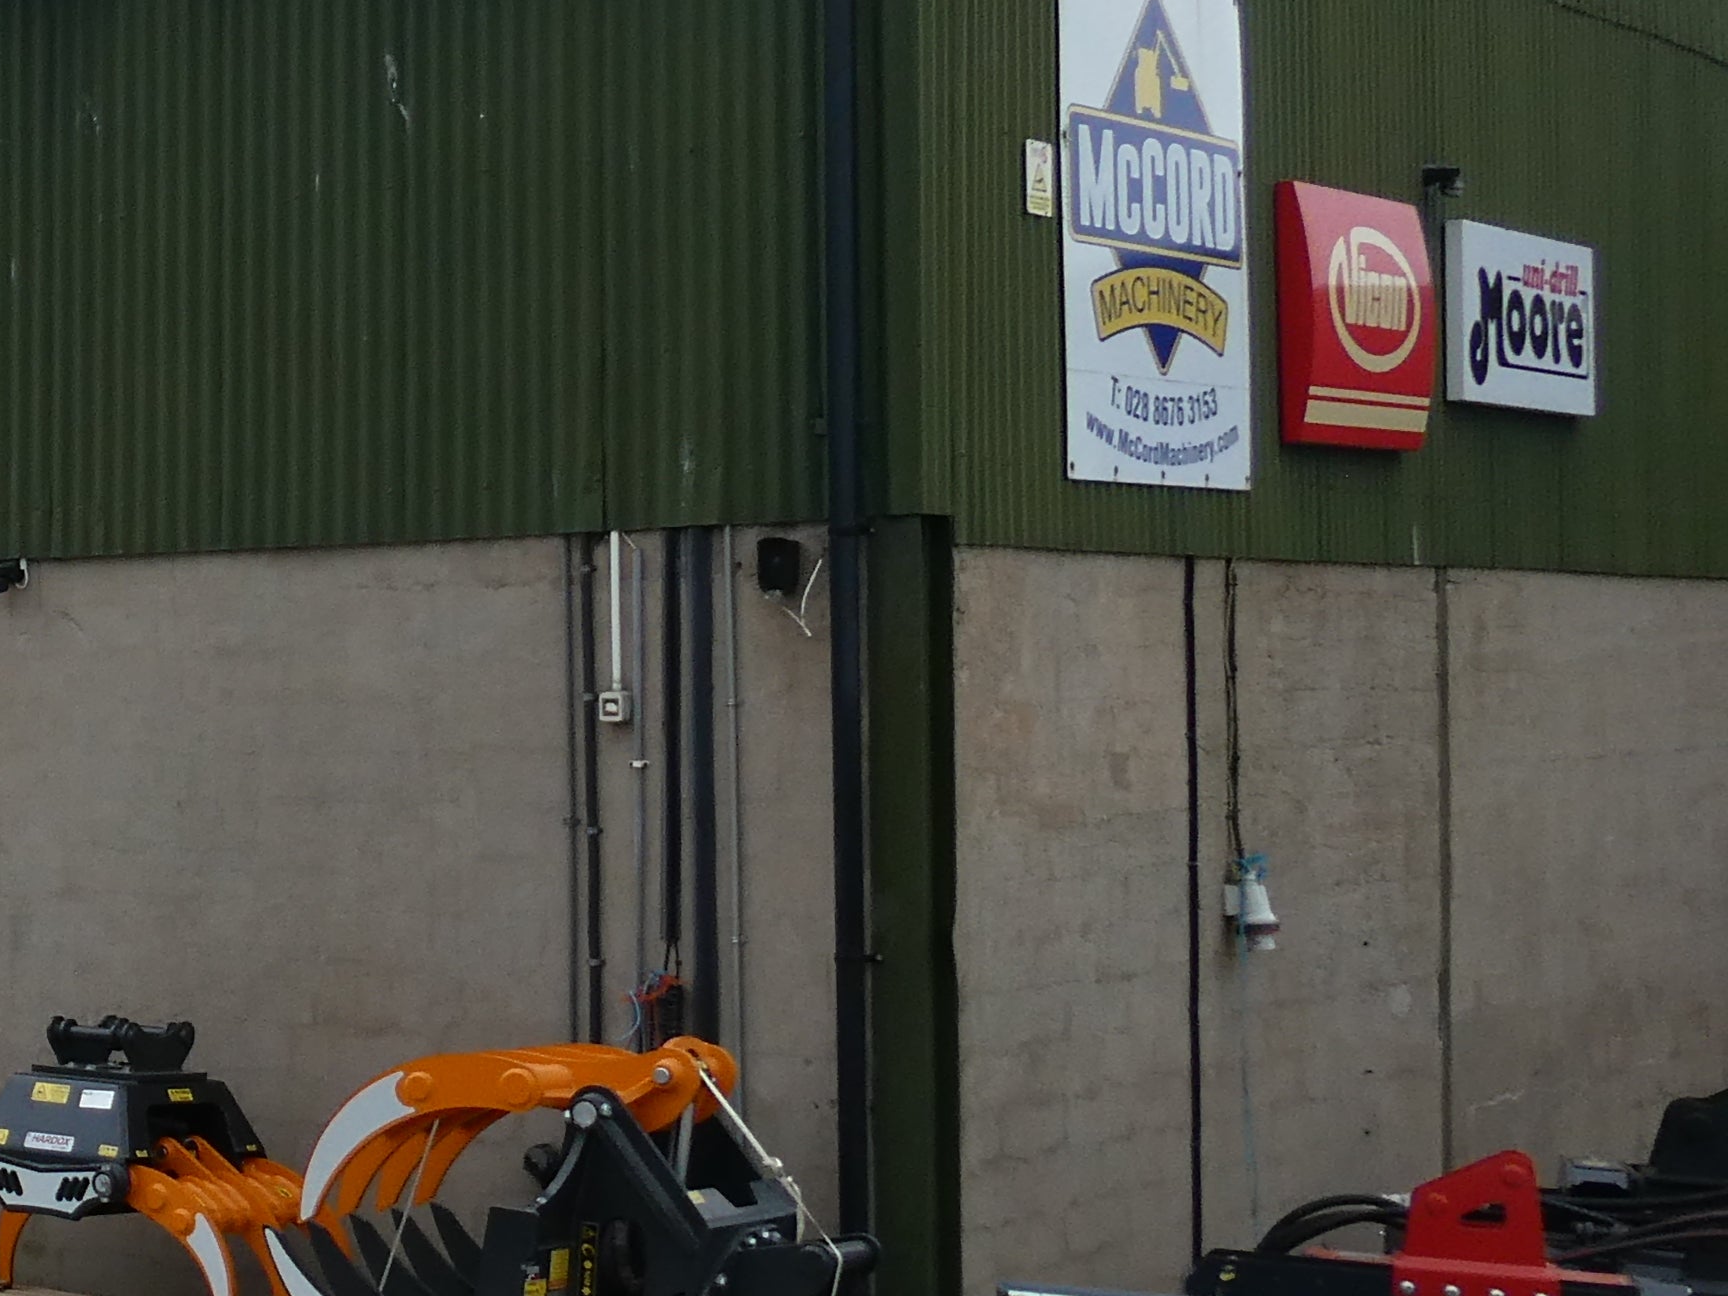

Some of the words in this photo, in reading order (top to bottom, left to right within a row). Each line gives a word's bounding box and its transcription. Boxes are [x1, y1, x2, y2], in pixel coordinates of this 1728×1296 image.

[1522, 259, 1578, 297] uni-drill
[1098, 275, 1223, 338] MACHINERY
[1469, 266, 1584, 386] Moore
[1110, 375, 1122, 410] T:
[1124, 385, 1149, 422] 028
[1152, 394, 1184, 426] 8676
[1187, 387, 1218, 424] 3153
[1086, 411, 1239, 466] www.McCordMachinery.com
